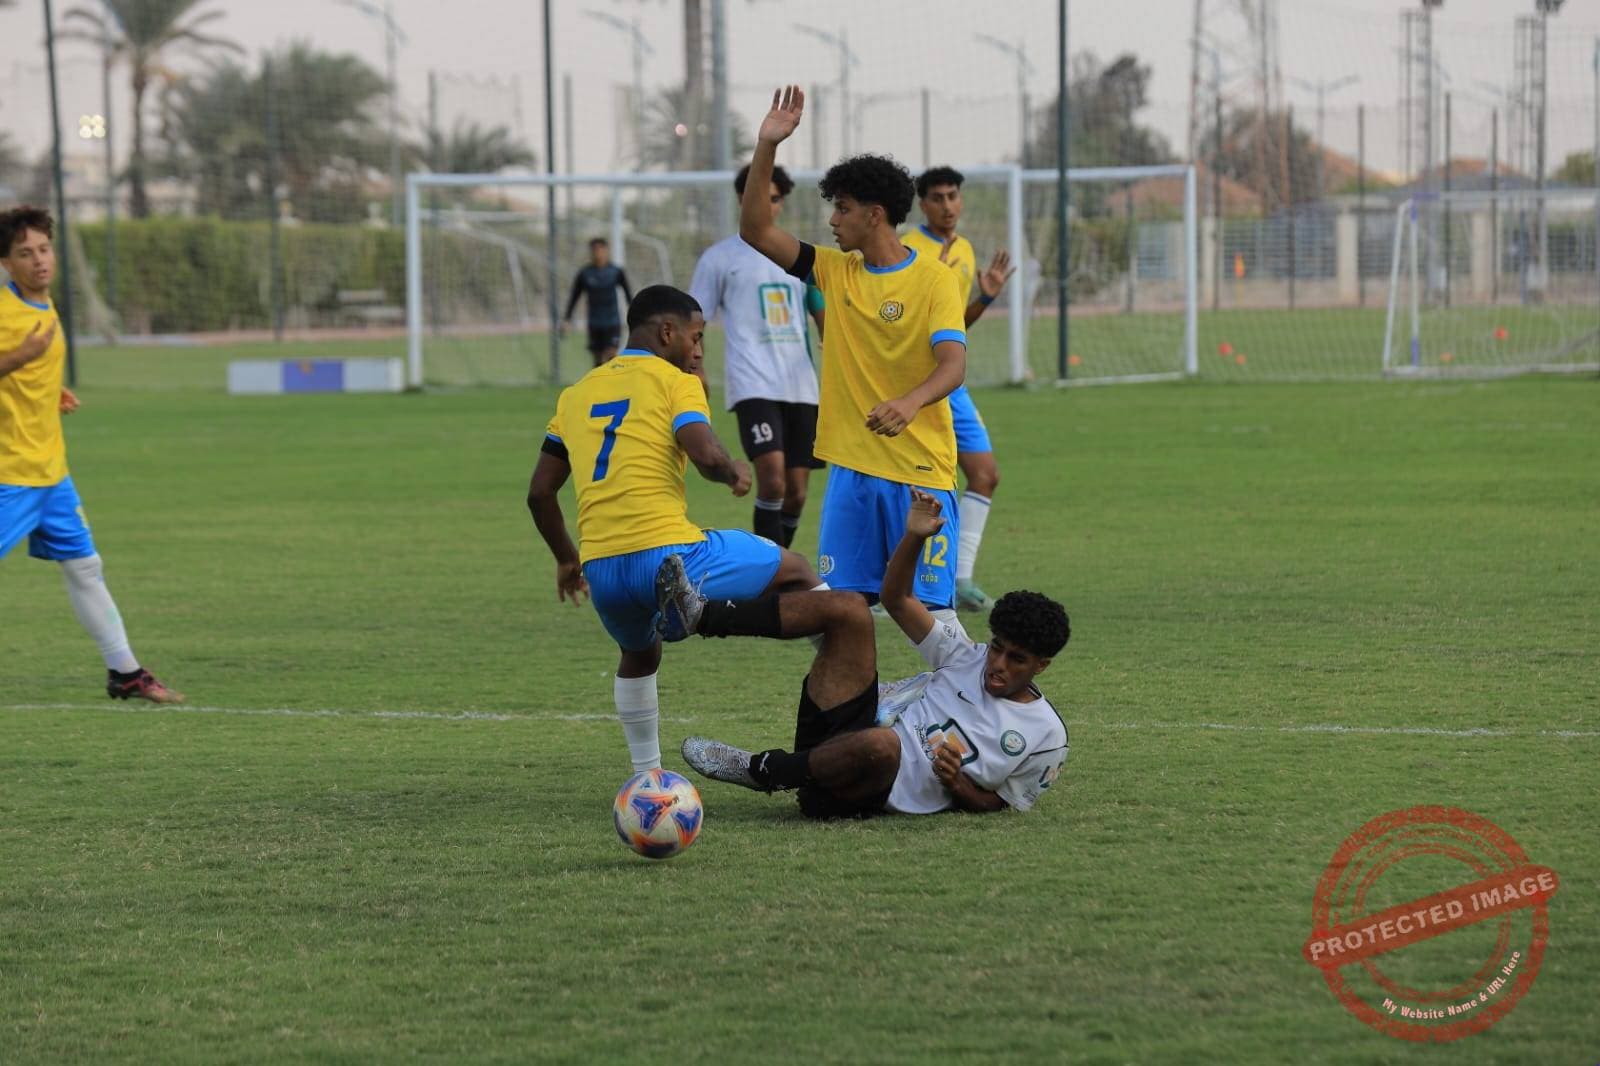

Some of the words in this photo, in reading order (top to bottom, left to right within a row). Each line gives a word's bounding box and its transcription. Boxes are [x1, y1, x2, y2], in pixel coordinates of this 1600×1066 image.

[590, 398, 631, 482] 7
[751, 421, 775, 445] 19
[923, 534, 948, 567] 12
